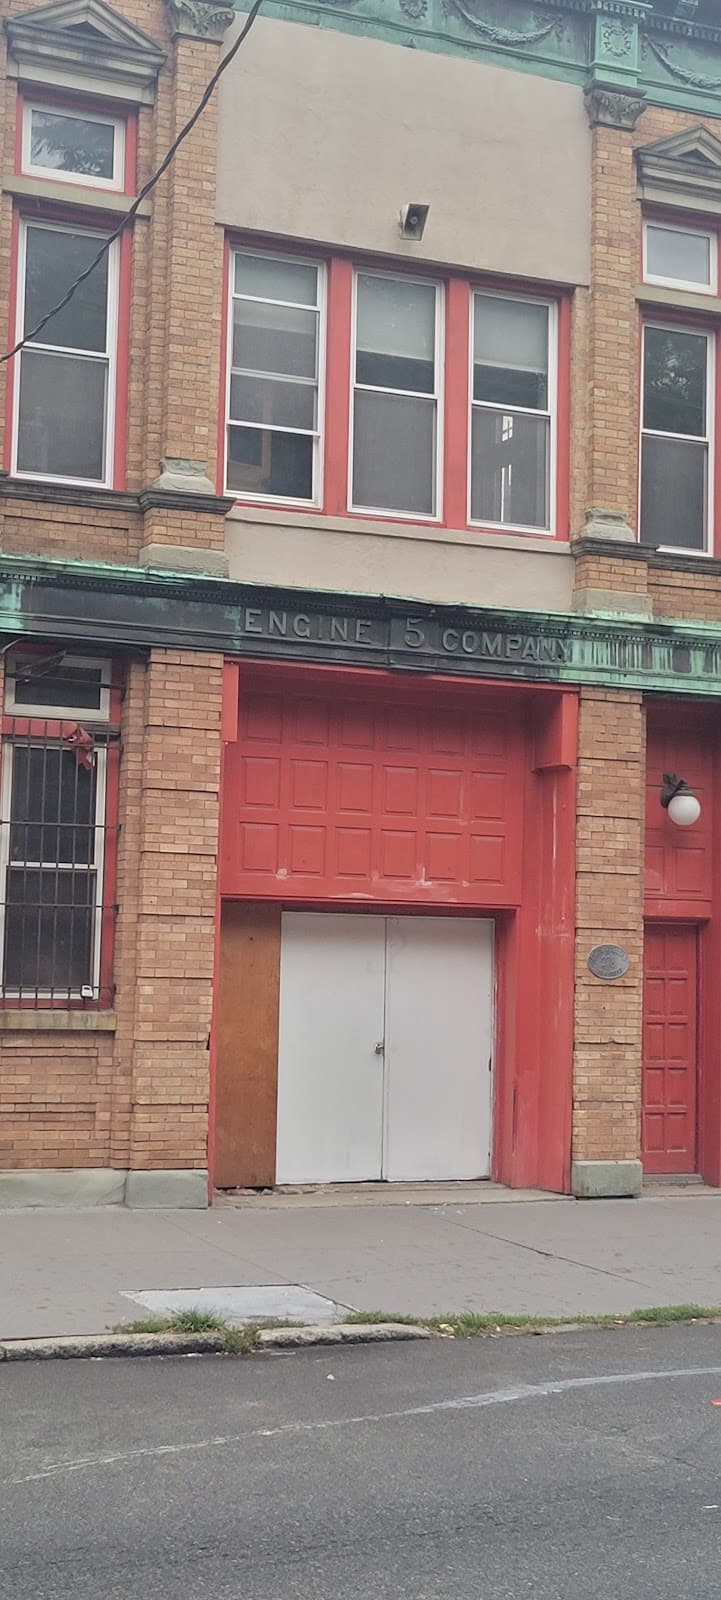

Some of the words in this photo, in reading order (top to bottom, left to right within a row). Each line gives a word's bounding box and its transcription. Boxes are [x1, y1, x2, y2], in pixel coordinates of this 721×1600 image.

[244, 608, 374, 645] ENGINE
[402, 616, 425, 648] 5
[442, 629, 573, 663] COMPANY
